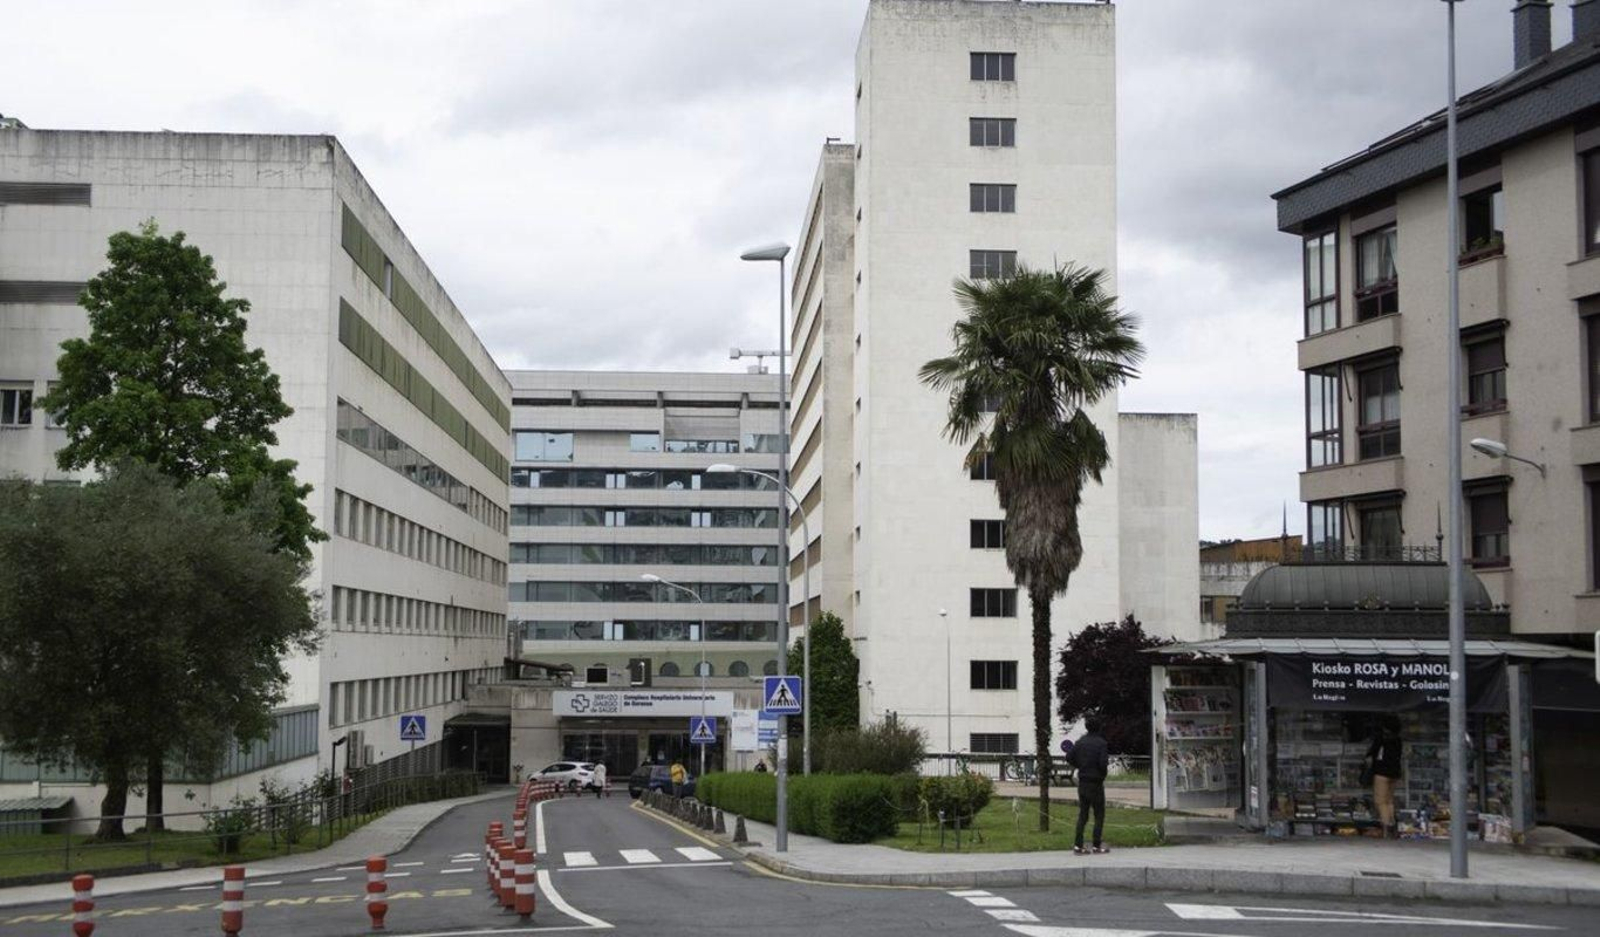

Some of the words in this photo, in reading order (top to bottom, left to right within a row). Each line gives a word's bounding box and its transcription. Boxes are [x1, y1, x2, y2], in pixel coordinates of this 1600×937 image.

[1312, 662, 1351, 674] Kiosko
[1354, 663, 1388, 675] ROSA
[1391, 666, 1399, 678] y
[1402, 664, 1450, 675] MANOL
[1312, 679, 1345, 689] Prensa
[1356, 680, 1399, 690] Revistas
[1410, 680, 1450, 690] Golosin
